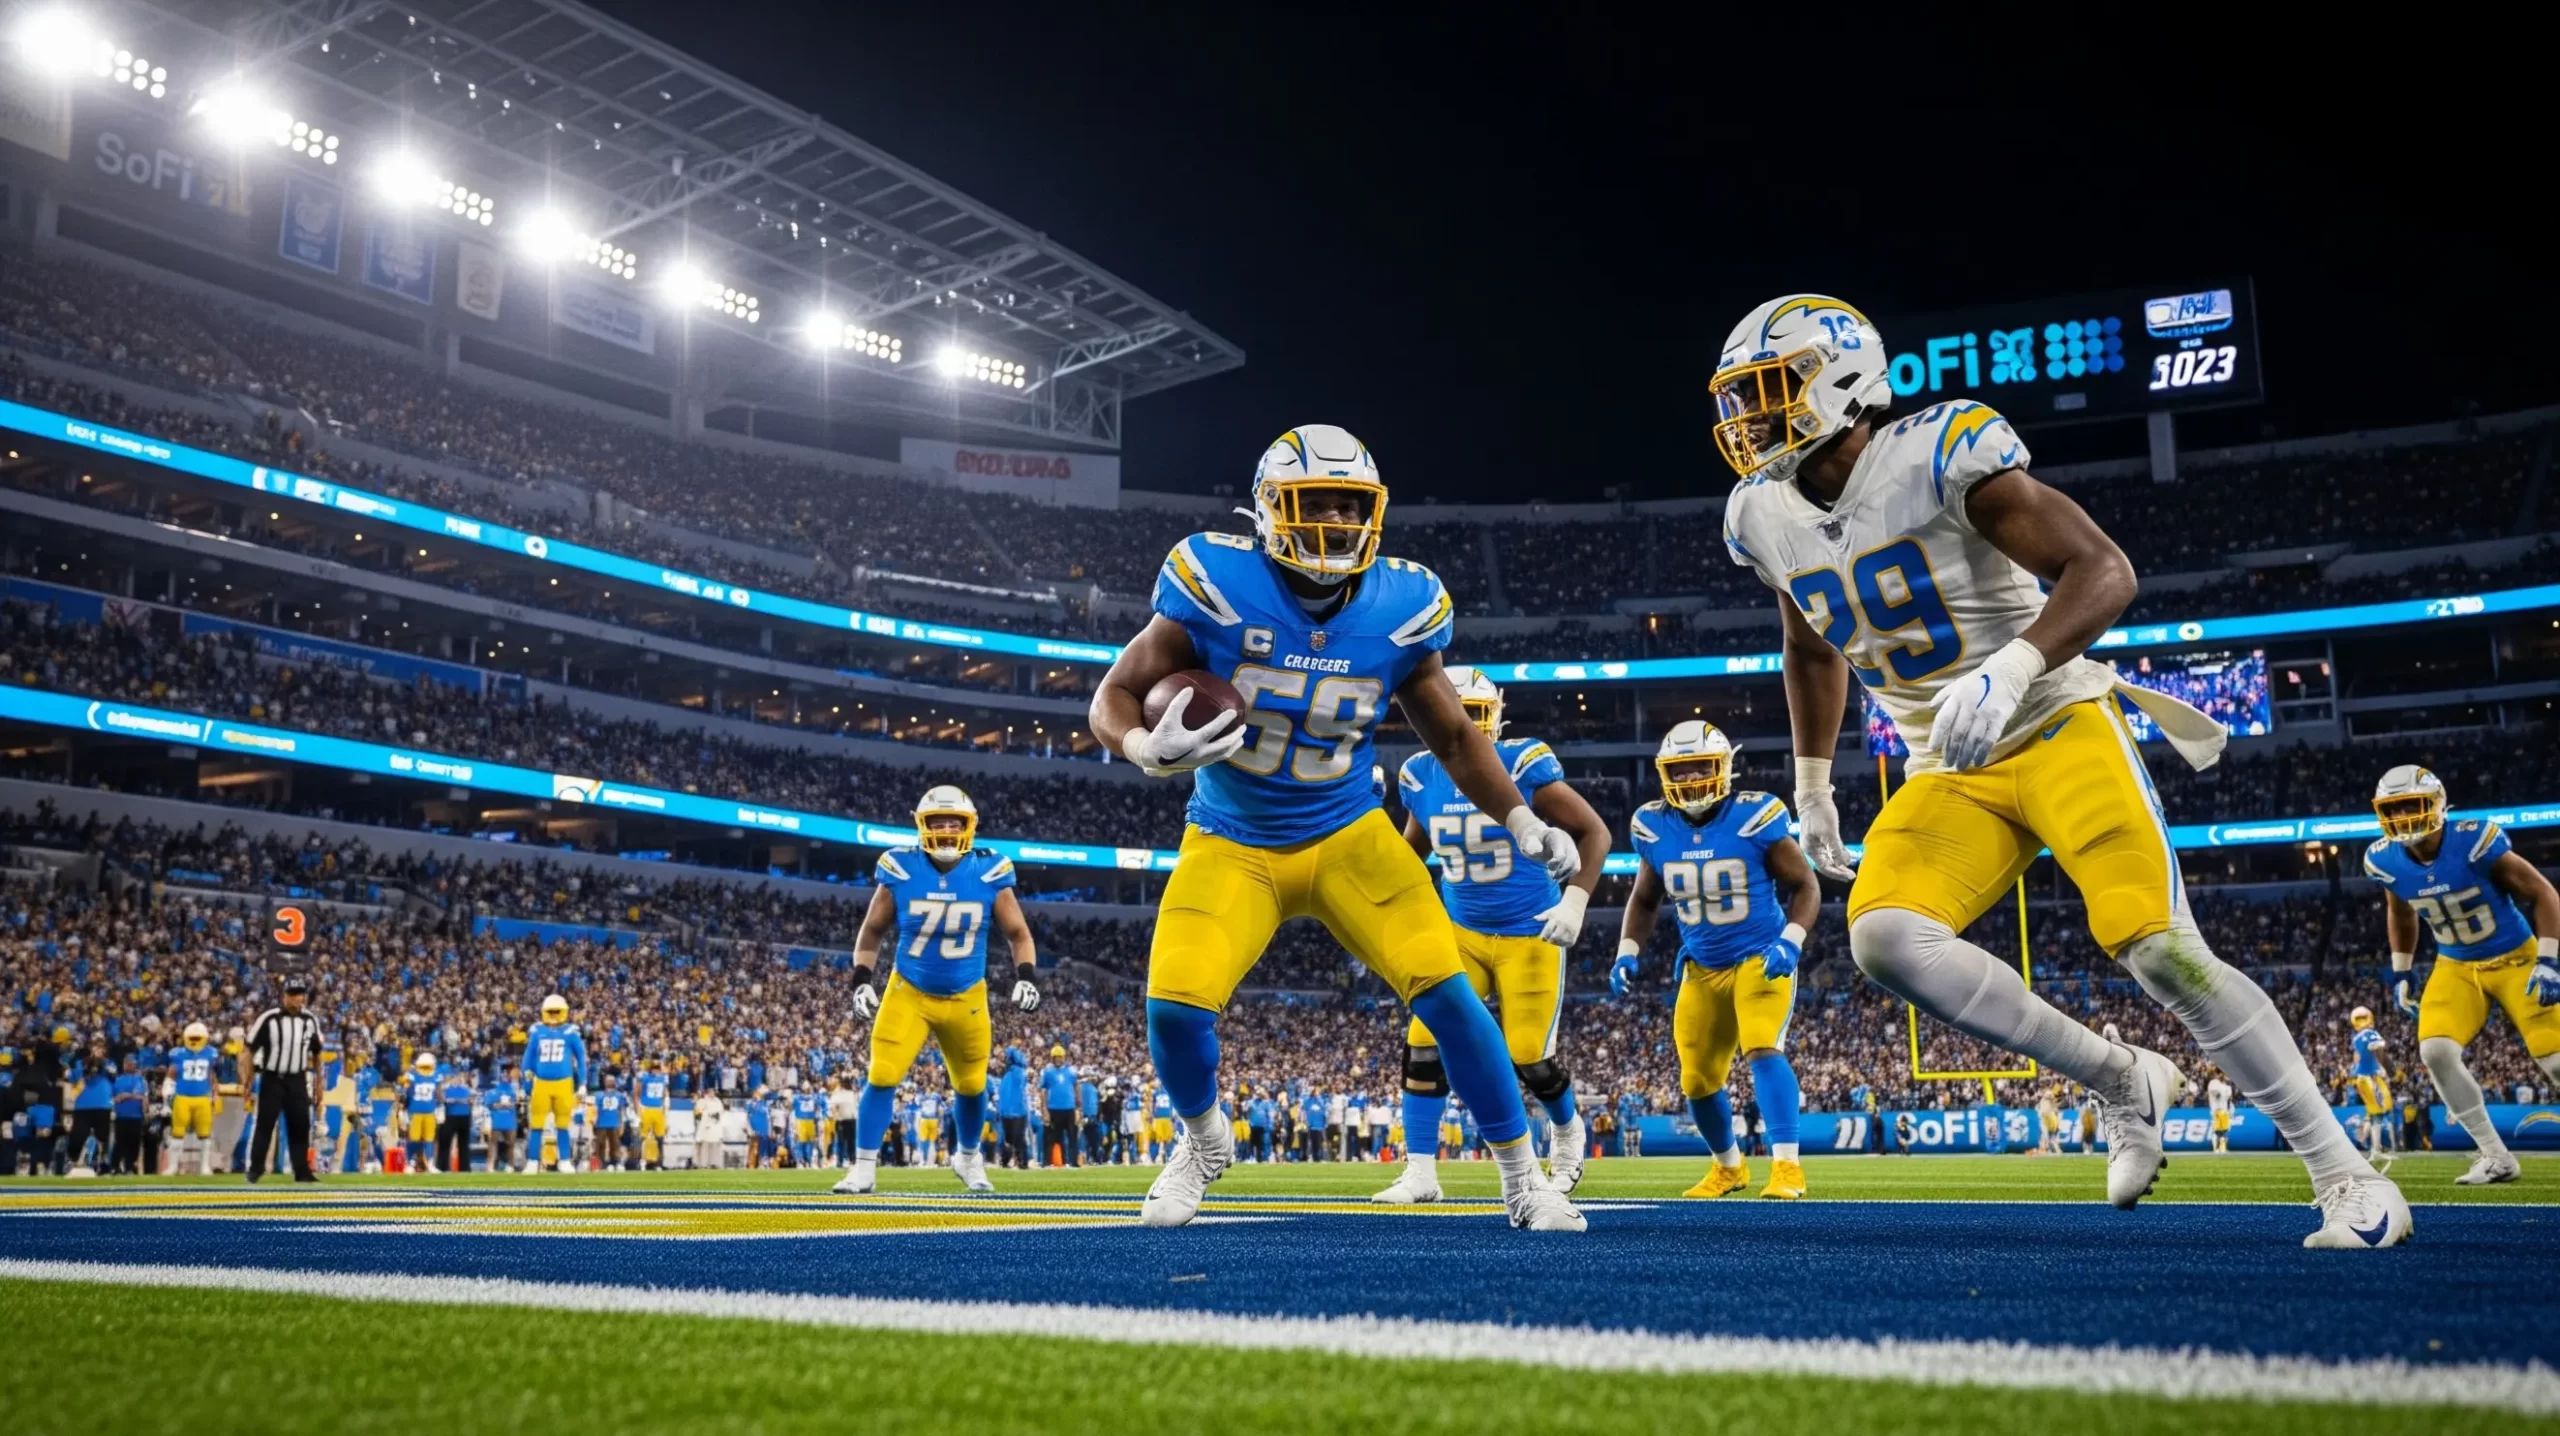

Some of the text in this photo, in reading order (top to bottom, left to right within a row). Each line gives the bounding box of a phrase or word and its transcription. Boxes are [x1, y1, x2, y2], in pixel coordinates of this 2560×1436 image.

[95, 131, 194, 200] SoFi
[1888, 333, 1979, 396] oFi
[1786, 536, 1966, 692] 29
[1226, 663, 1383, 782] 59
[1429, 813, 1513, 883] 55
[273, 906, 306, 946] 3
[908, 900, 984, 959] 79
